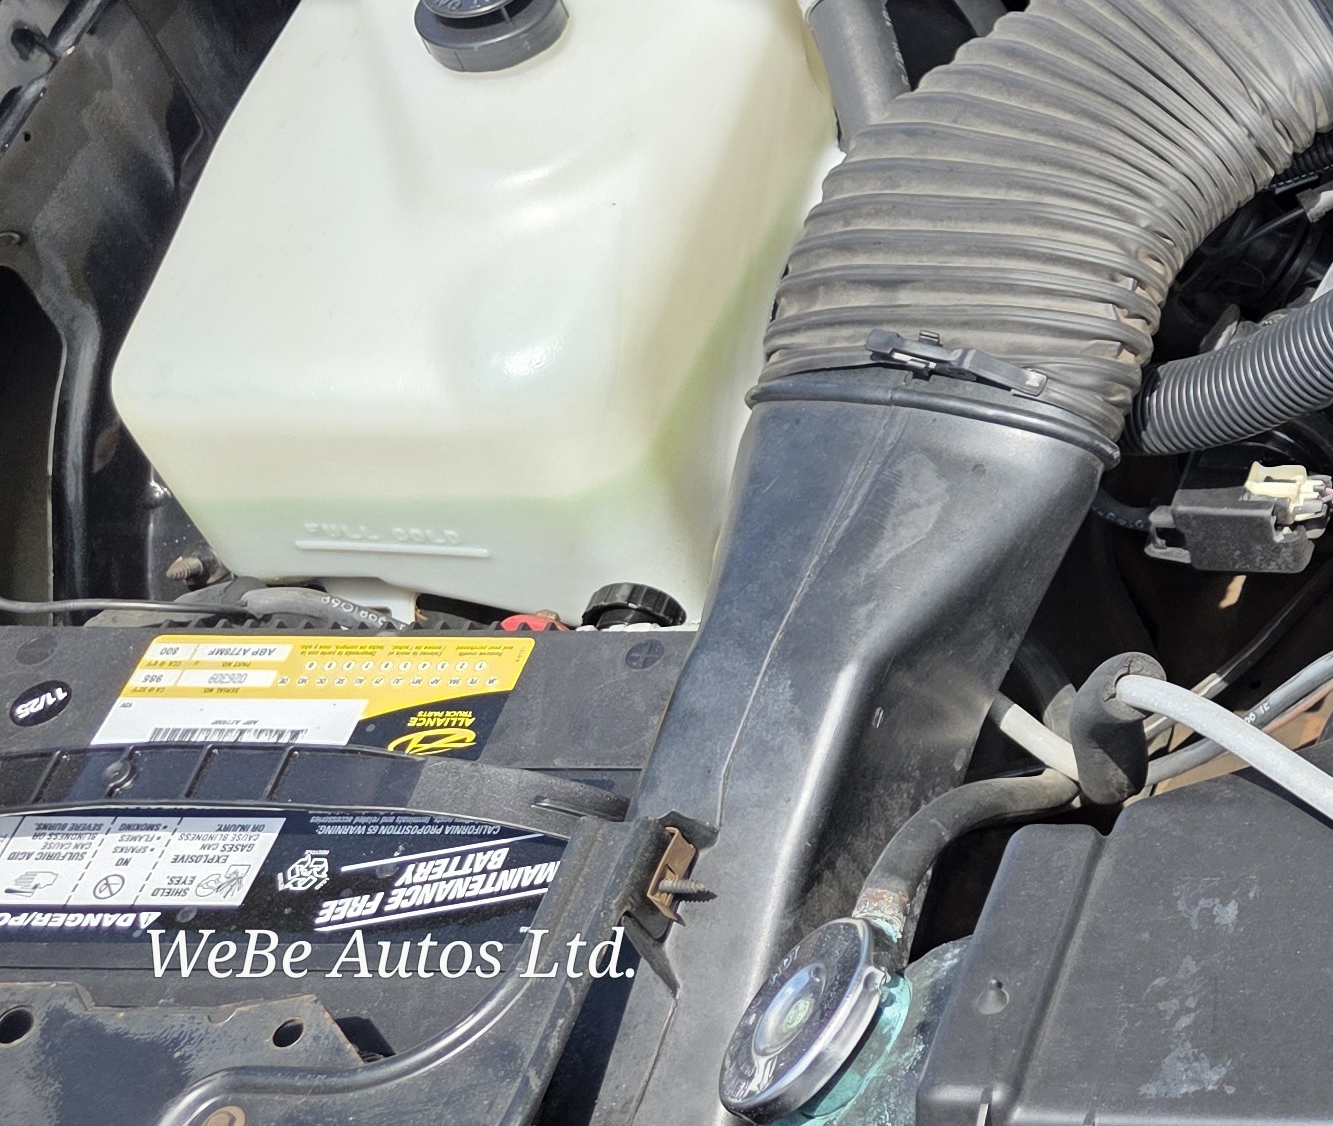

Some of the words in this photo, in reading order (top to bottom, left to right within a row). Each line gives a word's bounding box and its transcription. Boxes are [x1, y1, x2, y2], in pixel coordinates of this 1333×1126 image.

[160, 647, 179, 655] 800
[251, 647, 276, 656] ABP
[16, 687, 68, 718] 11/25
[407, 716, 475, 727] ALLIANCE
[35, 823, 65, 831] BURNS.
[66, 823, 103, 831] SEVERE
[120, 823, 162, 831] SMOKING
[216, 823, 251, 832] INJURY.
[316, 824, 366, 835] WARNING:
[367, 825, 378, 835] 65
[379, 825, 444, 835] PROPOSITION
[445, 825, 500, 835] CALIFORNIA
[32, 832, 47, 840] OR
[48, 832, 98, 840] BLINDNESS
[118, 834, 155, 842] FLAMES
[178, 833, 229, 842] BLINDNESS
[230, 833, 260, 842] CAUSE
[41, 841, 70, 850] CAUSE
[71, 842, 92, 850] CAN
[112, 845, 148, 854] SPARKS
[221, 843, 255, 852] GASES
[7, 851, 35, 861] ACID
[37, 851, 87, 861] SULFURIC
[170, 854, 229, 863] EXPLOSIVE
[115, 857, 132, 866] NO
[395, 847, 510, 886] BATTERY
[166, 875, 196, 885] EYES.
[384, 861, 560, 912] MAINTENANCE
[151, 888, 190, 897] SHIELD
[315, 891, 384, 924] FREE
